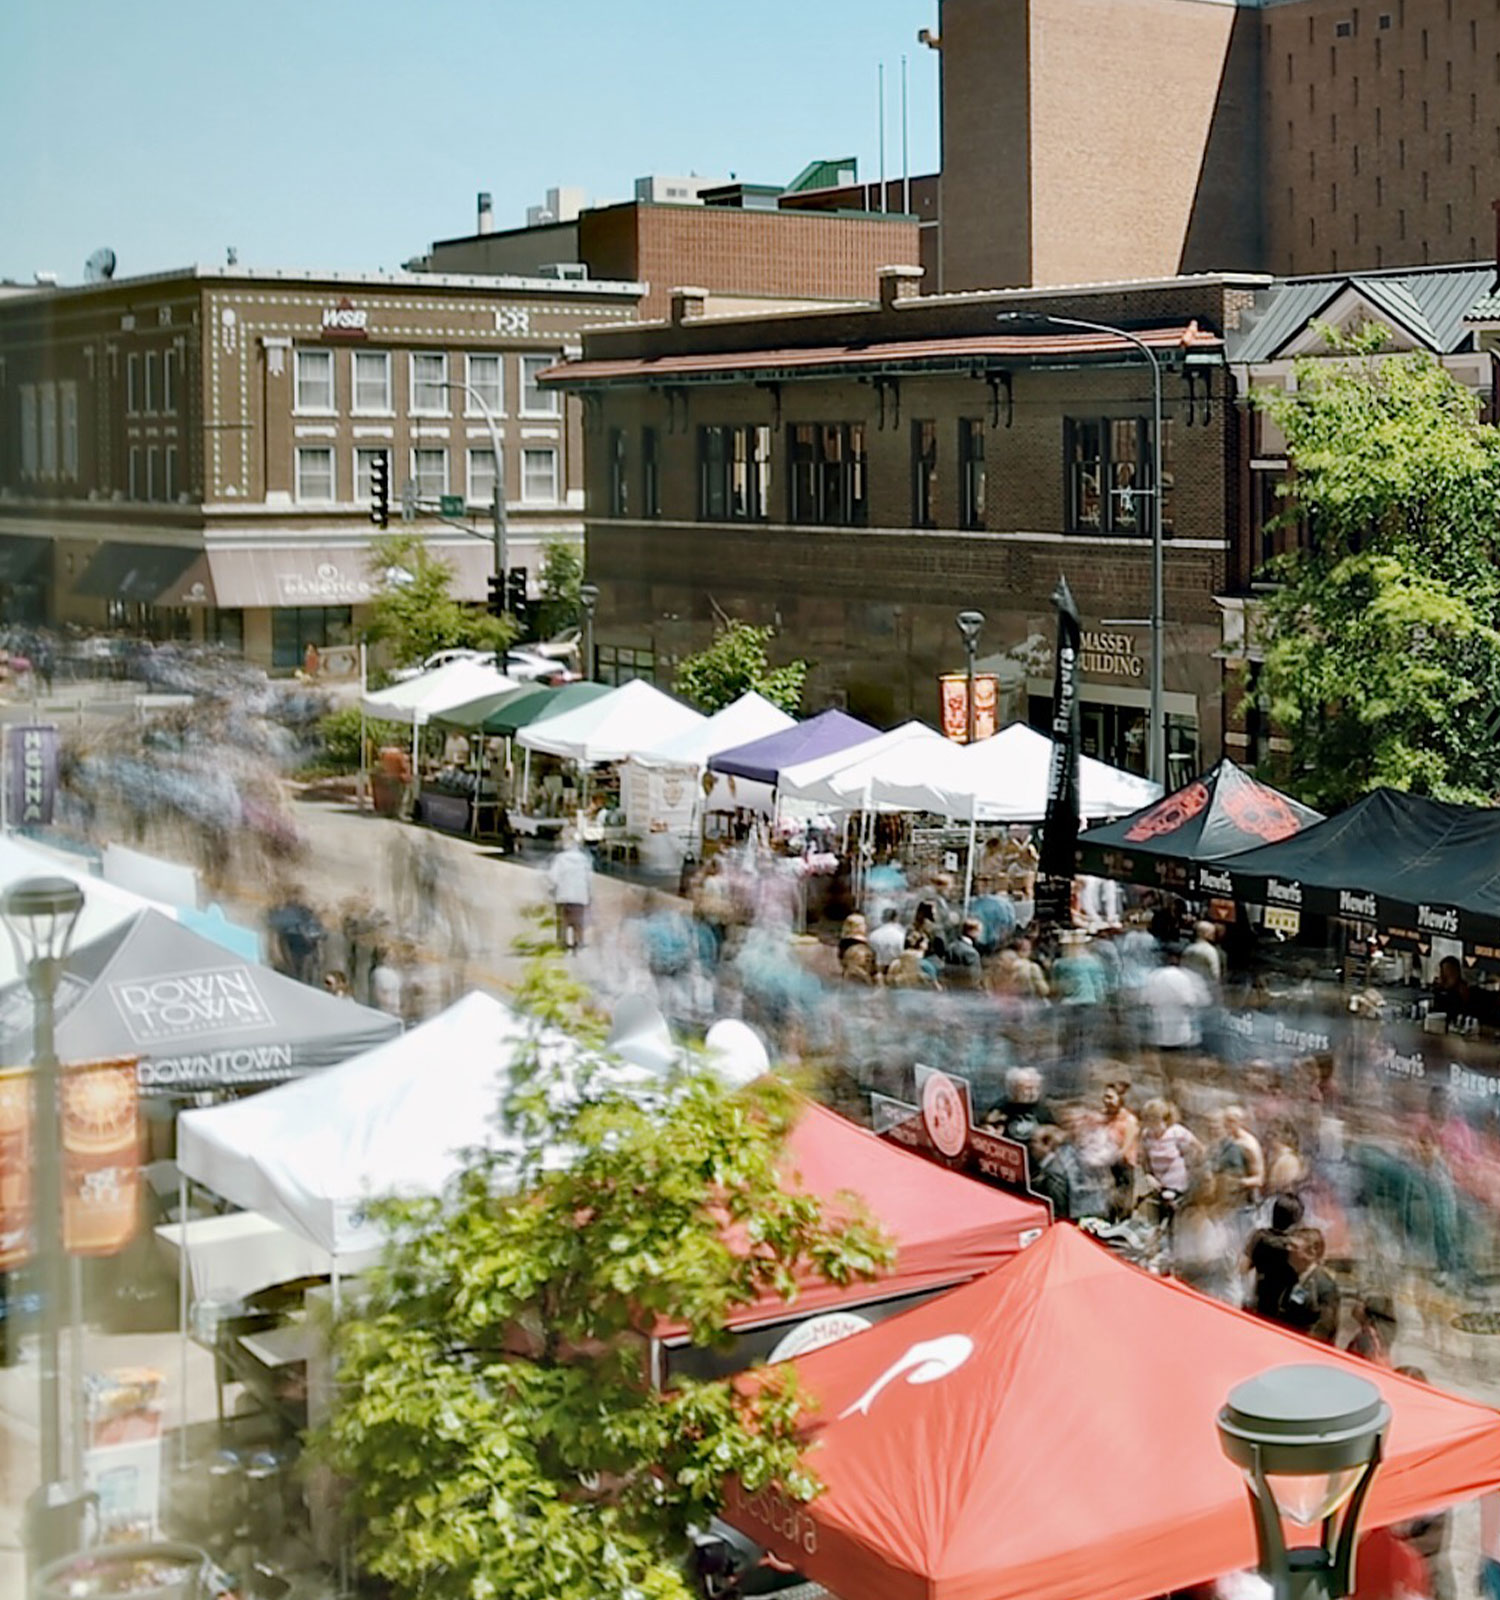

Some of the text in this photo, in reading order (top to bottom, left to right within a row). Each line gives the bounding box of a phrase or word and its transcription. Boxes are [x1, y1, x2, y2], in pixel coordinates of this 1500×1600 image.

[322, 309, 368, 328] WSB
[1079, 631, 1135, 653] MASSEY
[1339, 889, 1378, 916] Newt's
[1417, 904, 1459, 933] Newt's
[120, 971, 249, 1010] DOWN
[132, 994, 261, 1029] TOWN
[1274, 1019, 1330, 1052] Burgers
[136, 1043, 293, 1085] DOWNTOWN
